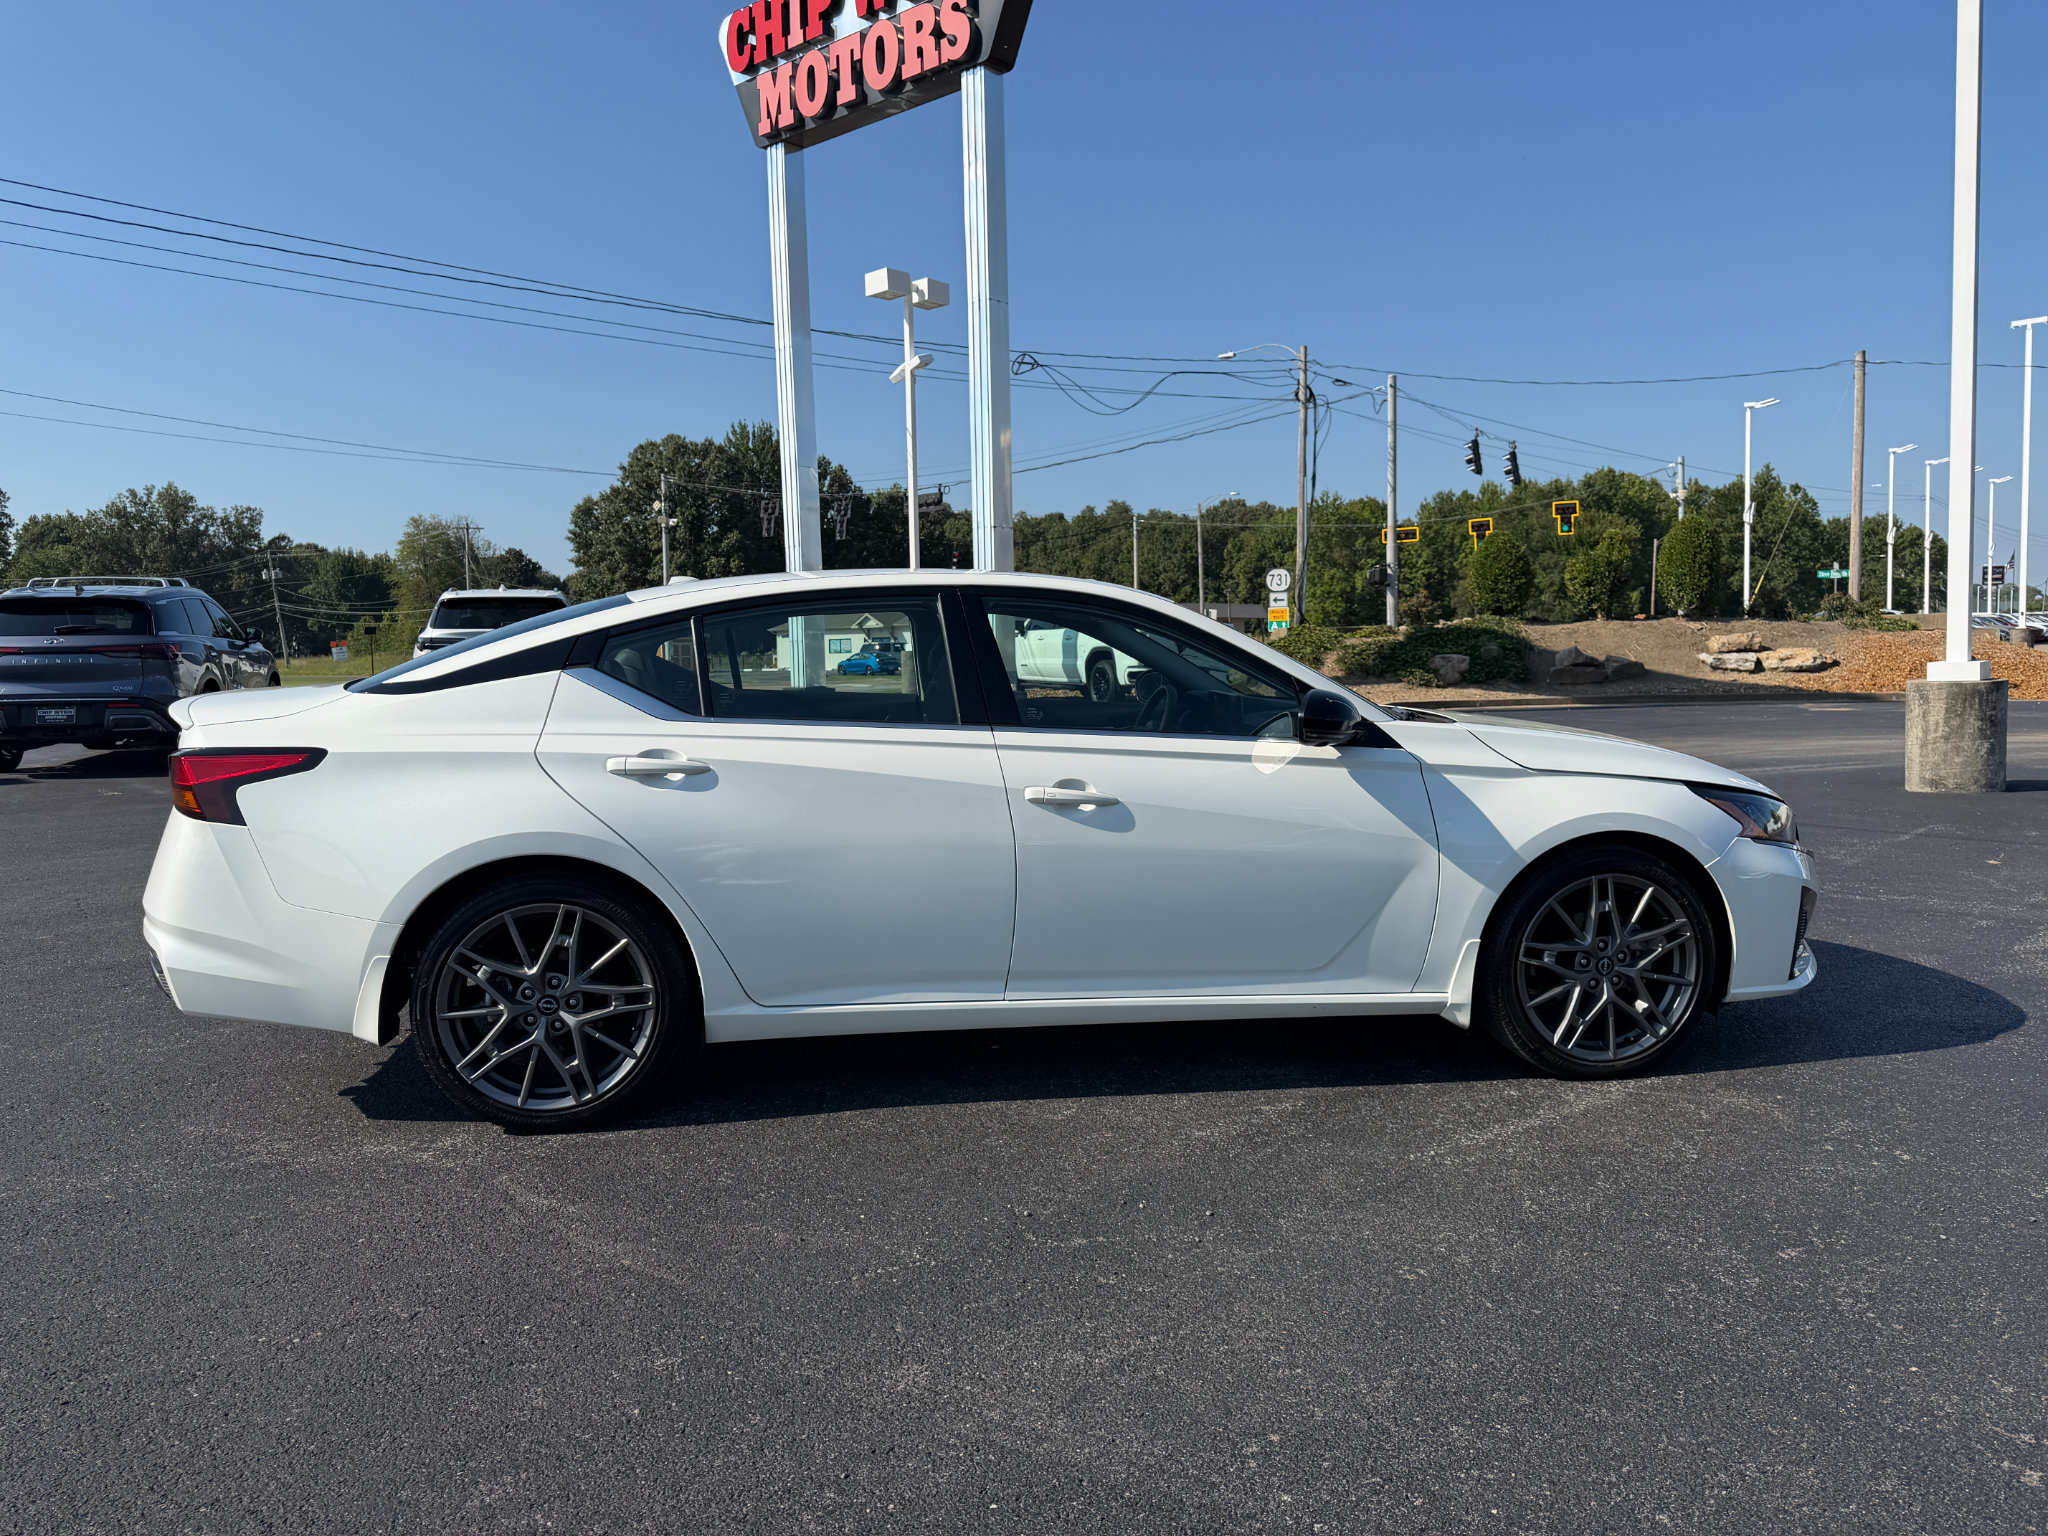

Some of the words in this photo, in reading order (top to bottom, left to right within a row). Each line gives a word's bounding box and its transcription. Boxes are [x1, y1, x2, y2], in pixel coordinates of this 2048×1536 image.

[727, 0, 831, 73] CHIP
[756, 0, 971, 136] MOTORS
[1268, 573, 1287, 587] 731
